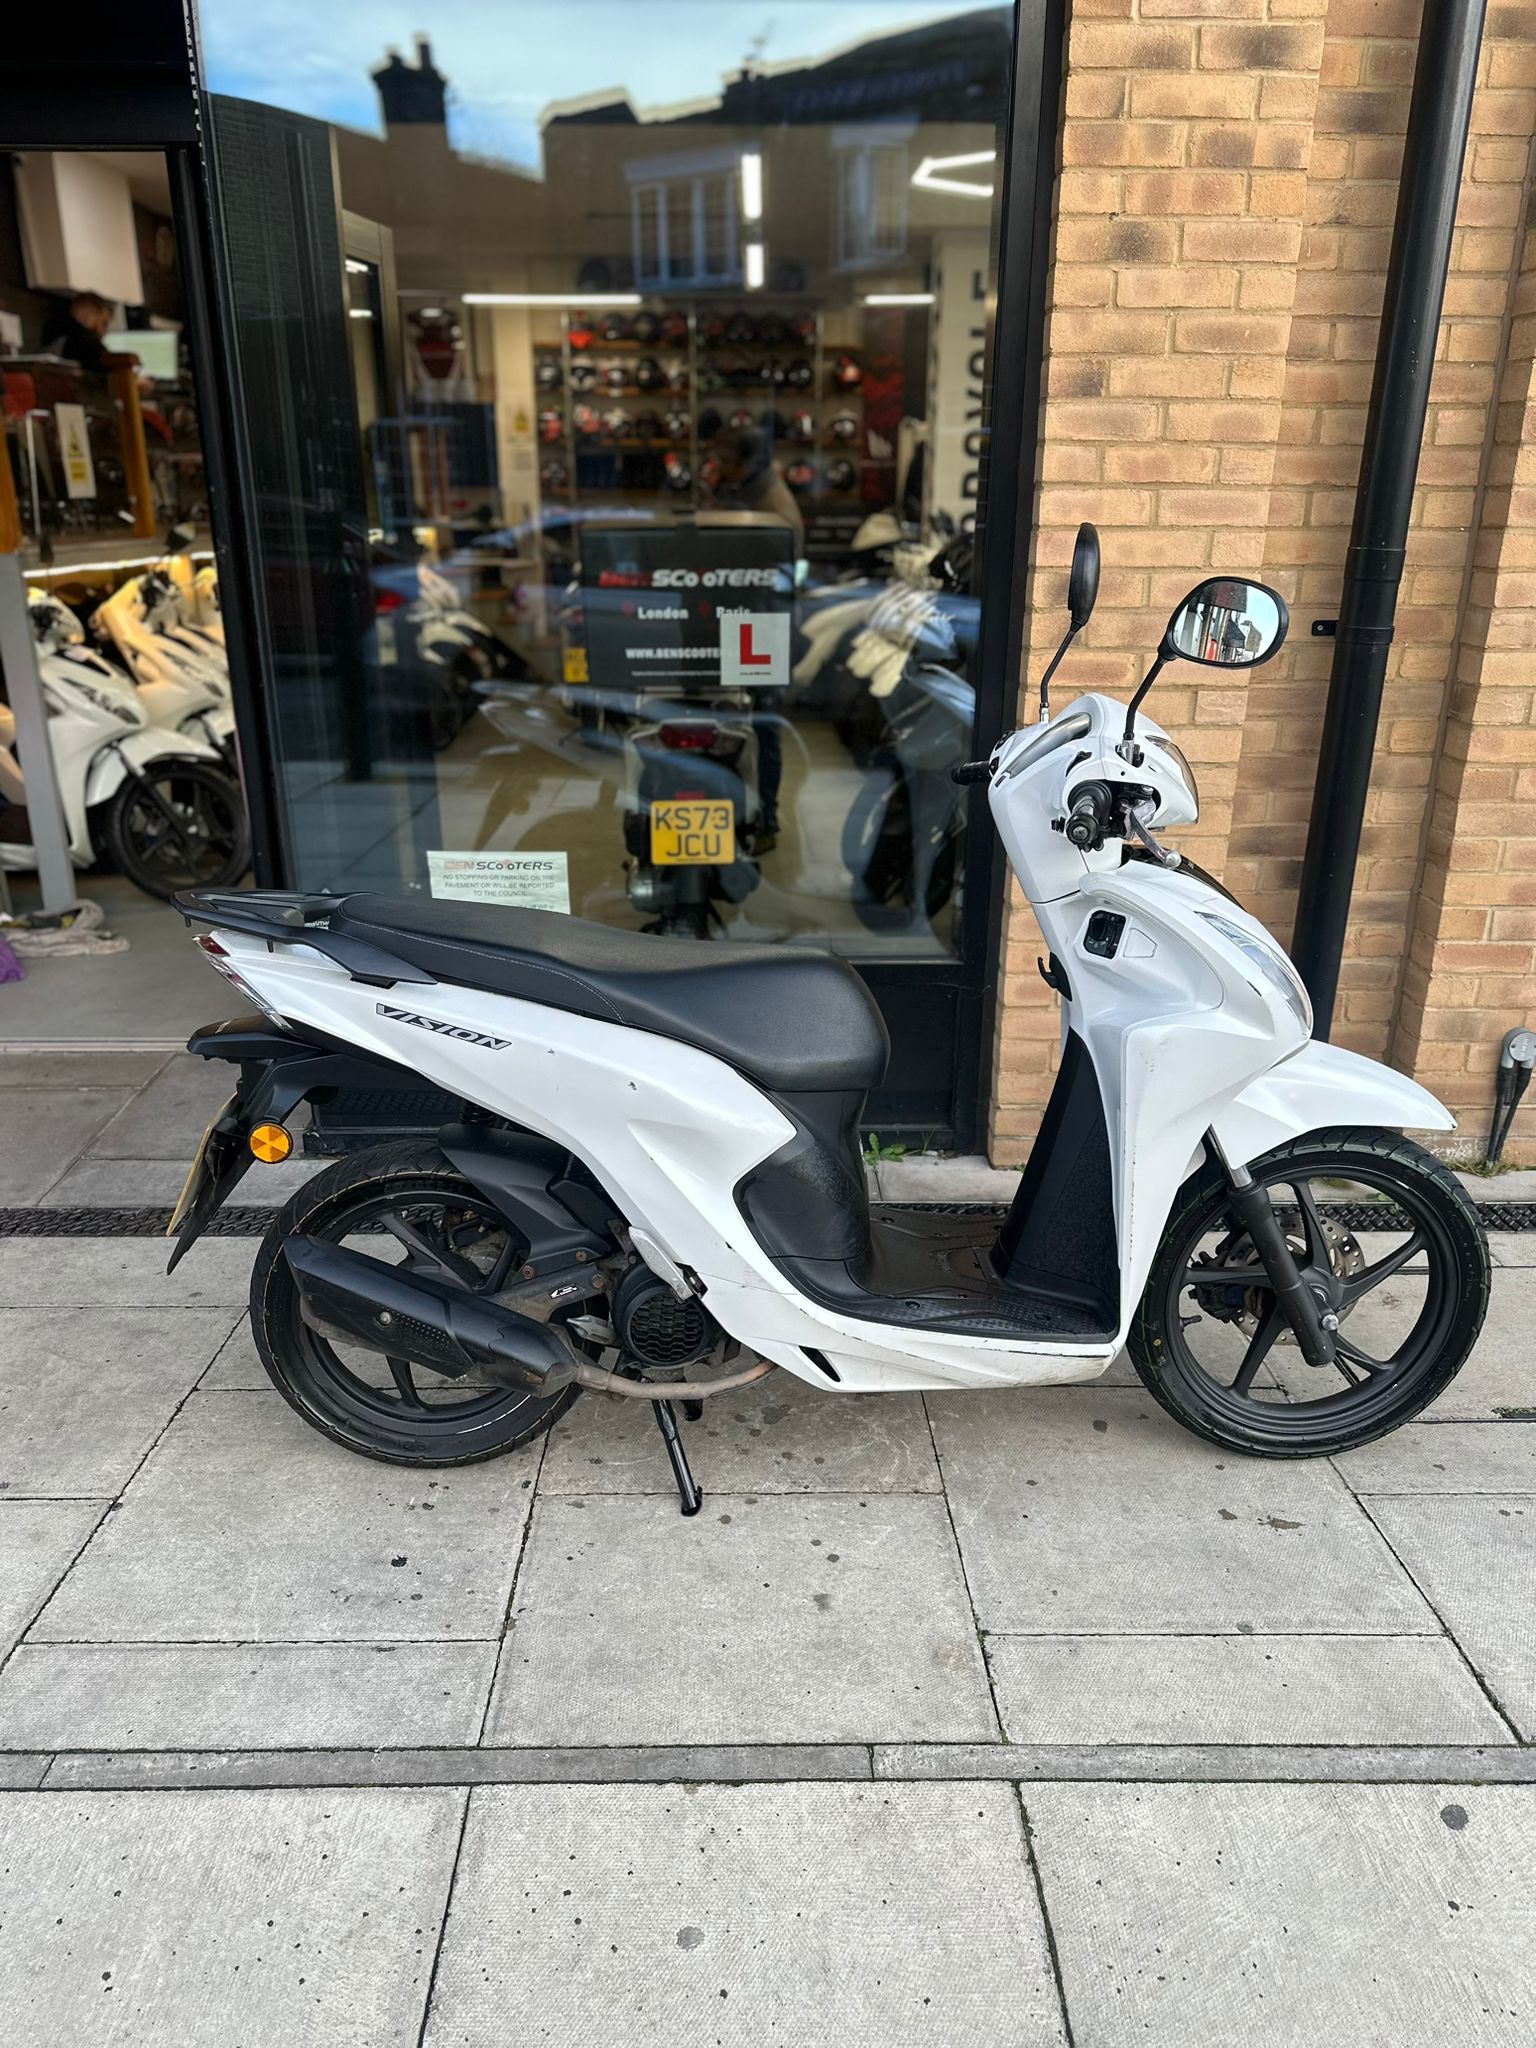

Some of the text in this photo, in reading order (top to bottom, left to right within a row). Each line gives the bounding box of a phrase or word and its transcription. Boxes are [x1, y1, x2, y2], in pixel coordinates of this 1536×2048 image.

[638, 607, 689, 620] London
[740, 624, 771, 664] L
[655, 807, 730, 830] KS73
[666, 834, 720, 857] JCU
[376, 1003, 513, 1050] VISION
